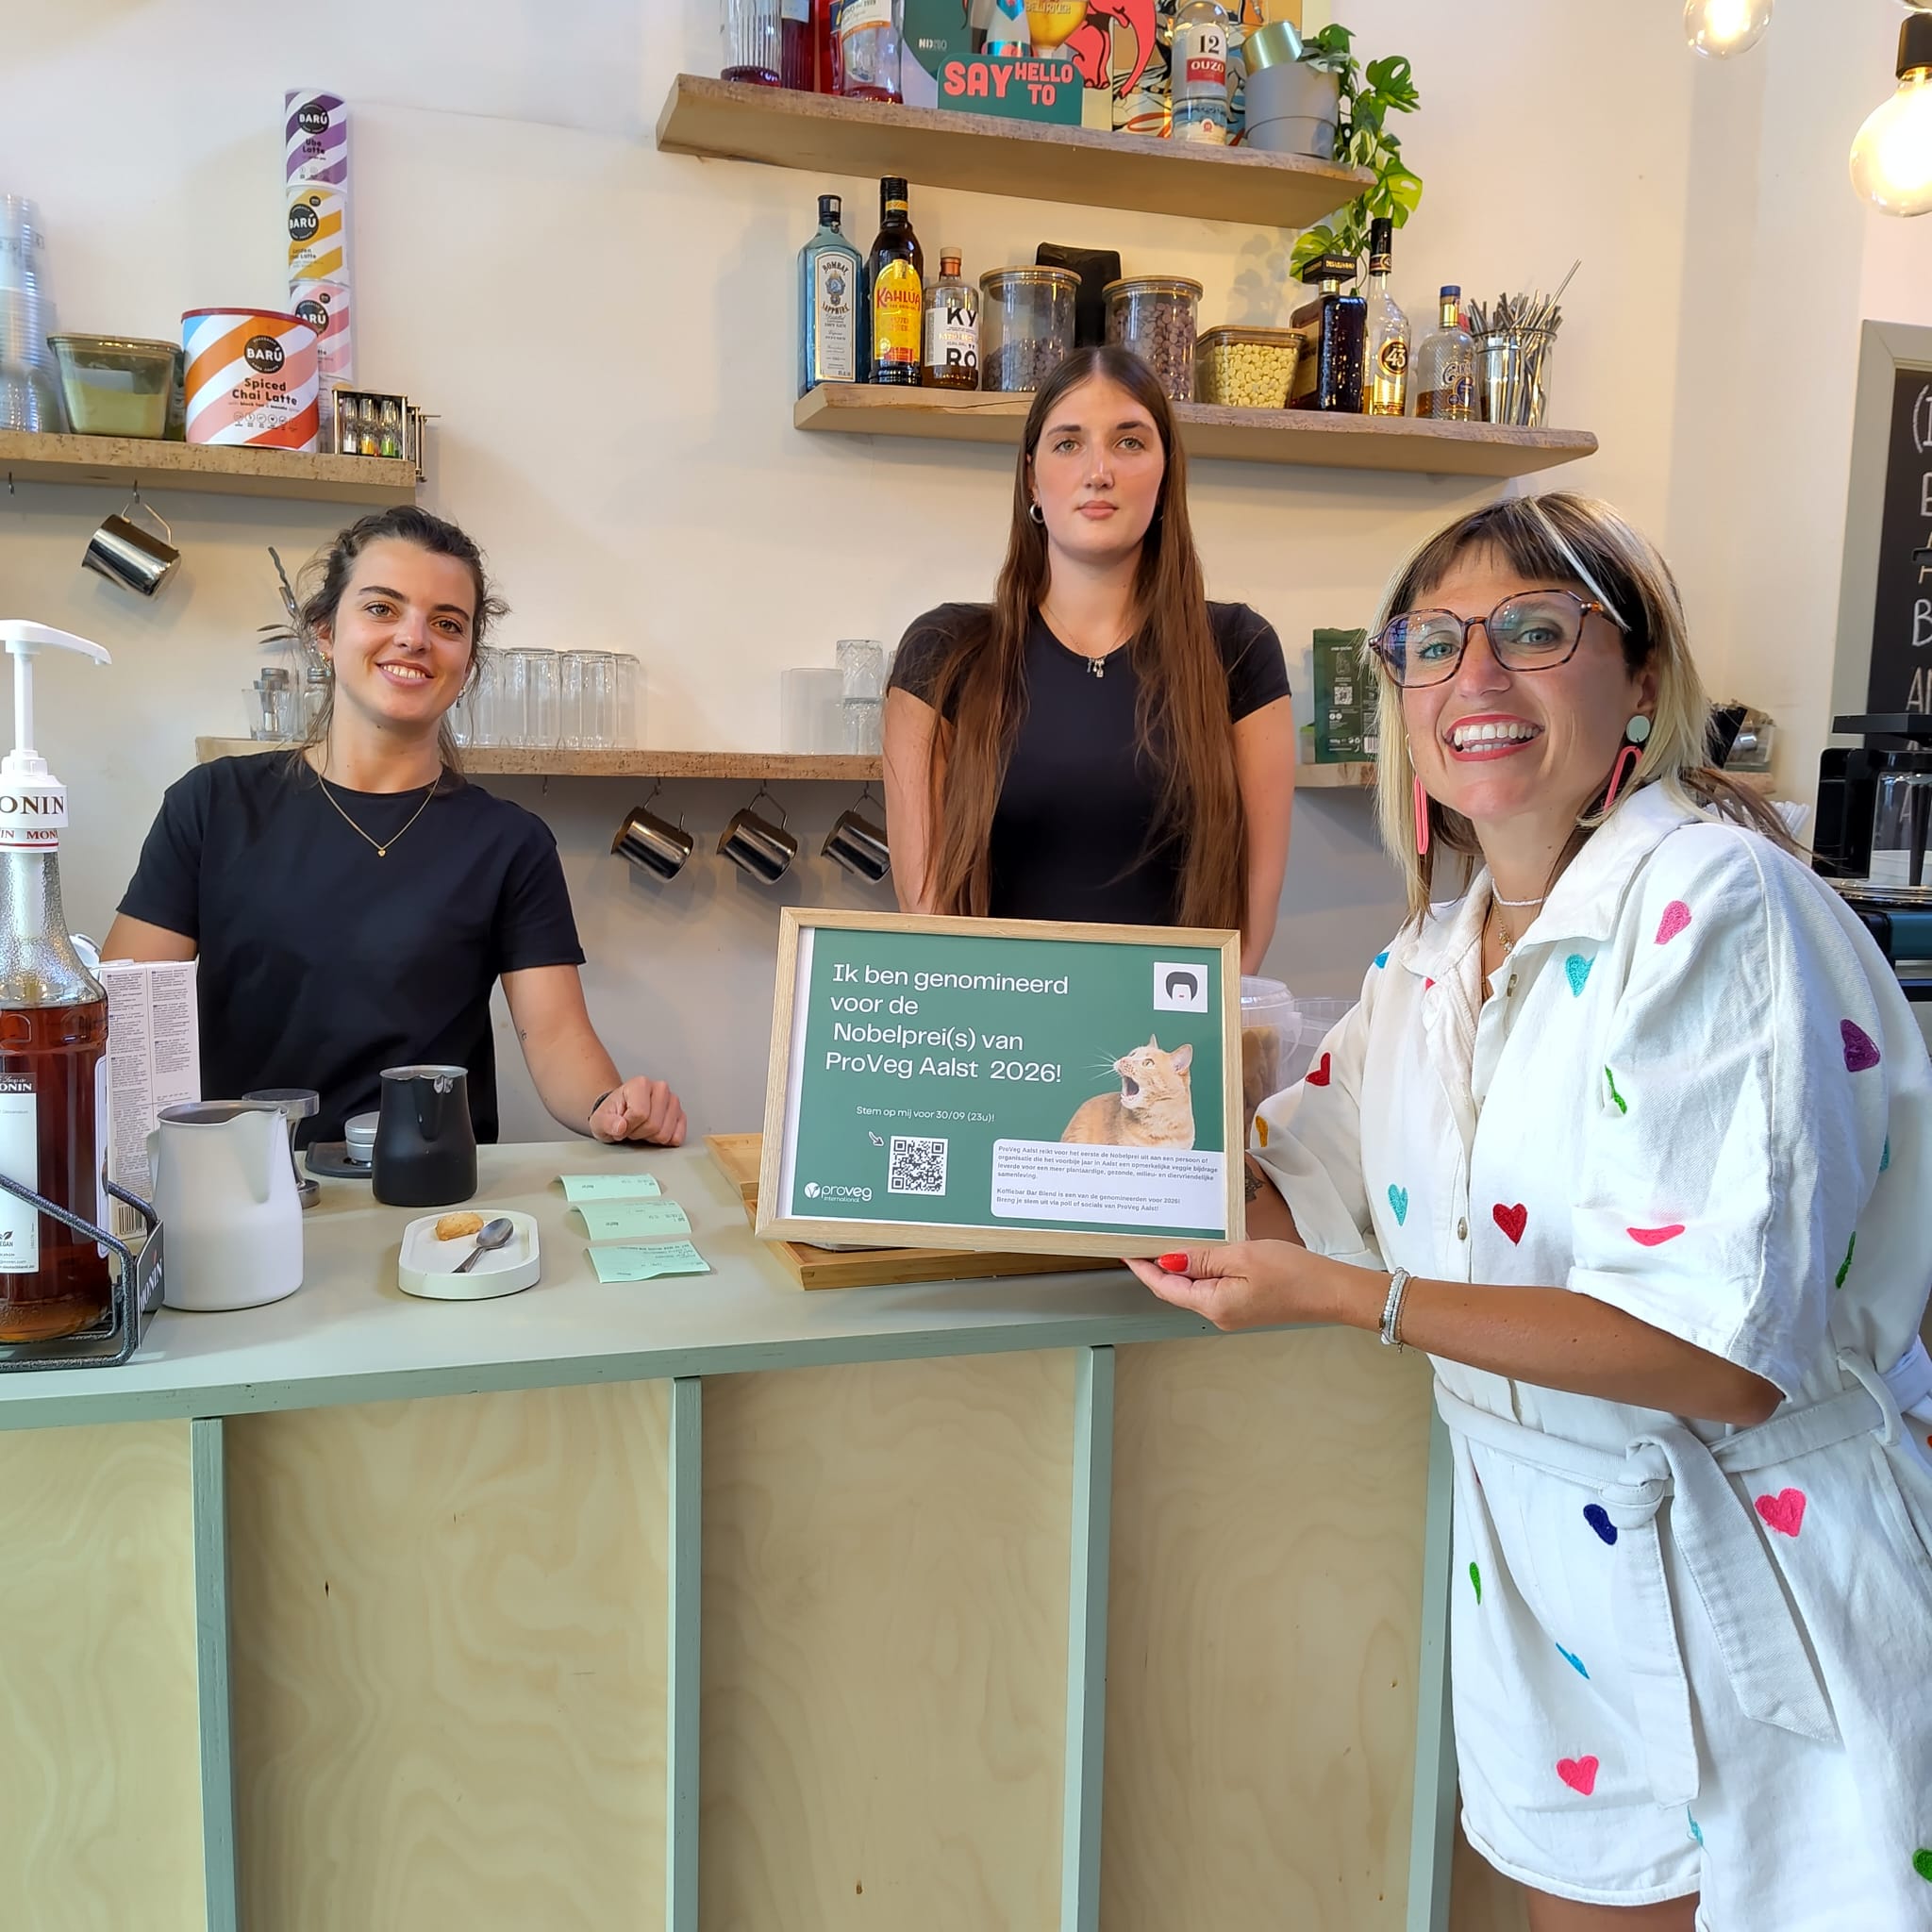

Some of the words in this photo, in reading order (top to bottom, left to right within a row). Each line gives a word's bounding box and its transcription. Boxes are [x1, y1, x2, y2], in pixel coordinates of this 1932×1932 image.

[1198, 34, 1220, 55] 12
[1191, 60, 1224, 73] OUZO
[943, 60, 1014, 98] SAY
[1014, 61, 1074, 84] HELLO
[1027, 83, 1057, 107] TO
[298, 111, 327, 125] BARÚ
[302, 145, 325, 155] Latte
[822, 260, 849, 276] BOMBAY
[876, 288, 921, 311] KAHLÚA
[822, 301, 851, 315] SAPPHIRE
[296, 311, 326, 325] ARÚ
[947, 308, 977, 327] KY
[246, 346, 283, 362] BARÚ
[1385, 347, 1407, 369] 43
[244, 377, 287, 391] Spiced
[232, 389, 260, 400] Chai
[265, 391, 298, 406] Latte
[832, 963, 859, 983] Ik
[864, 964, 908, 985] ben
[914, 973, 1069, 994] genomineerd
[830, 995, 884, 1013] voor
[889, 995, 919, 1015] de
[833, 1023, 976, 1052] Nobelprei(s)
[981, 1034, 1024, 1051] van
[825, 1052, 913, 1079] ProVeg
[919, 1057, 979, 1078] Aalst
[990, 1060, 1062, 1083] 2026!
[856, 1106, 882, 1116] Stem
[883, 1108, 896, 1118] op
[897, 1108, 912, 1120] mij
[936, 1110, 965, 1121] 30/09
[967, 1111, 995, 1124] (23u)!
[997, 1171, 1038, 1179] samenleving.
[1066, 1166, 1107, 1175] plantaardige,
[1167, 1173, 1214, 1181] diervriendelijke
[1192, 1165, 1218, 1174] bijdrage
[821, 1185, 873, 1202] proveg
[1099, 1194, 1147, 1203] genomineerden
[996, 1196, 1016, 1205] Breng
[1117, 1203, 1140, 1211] ProVeg
